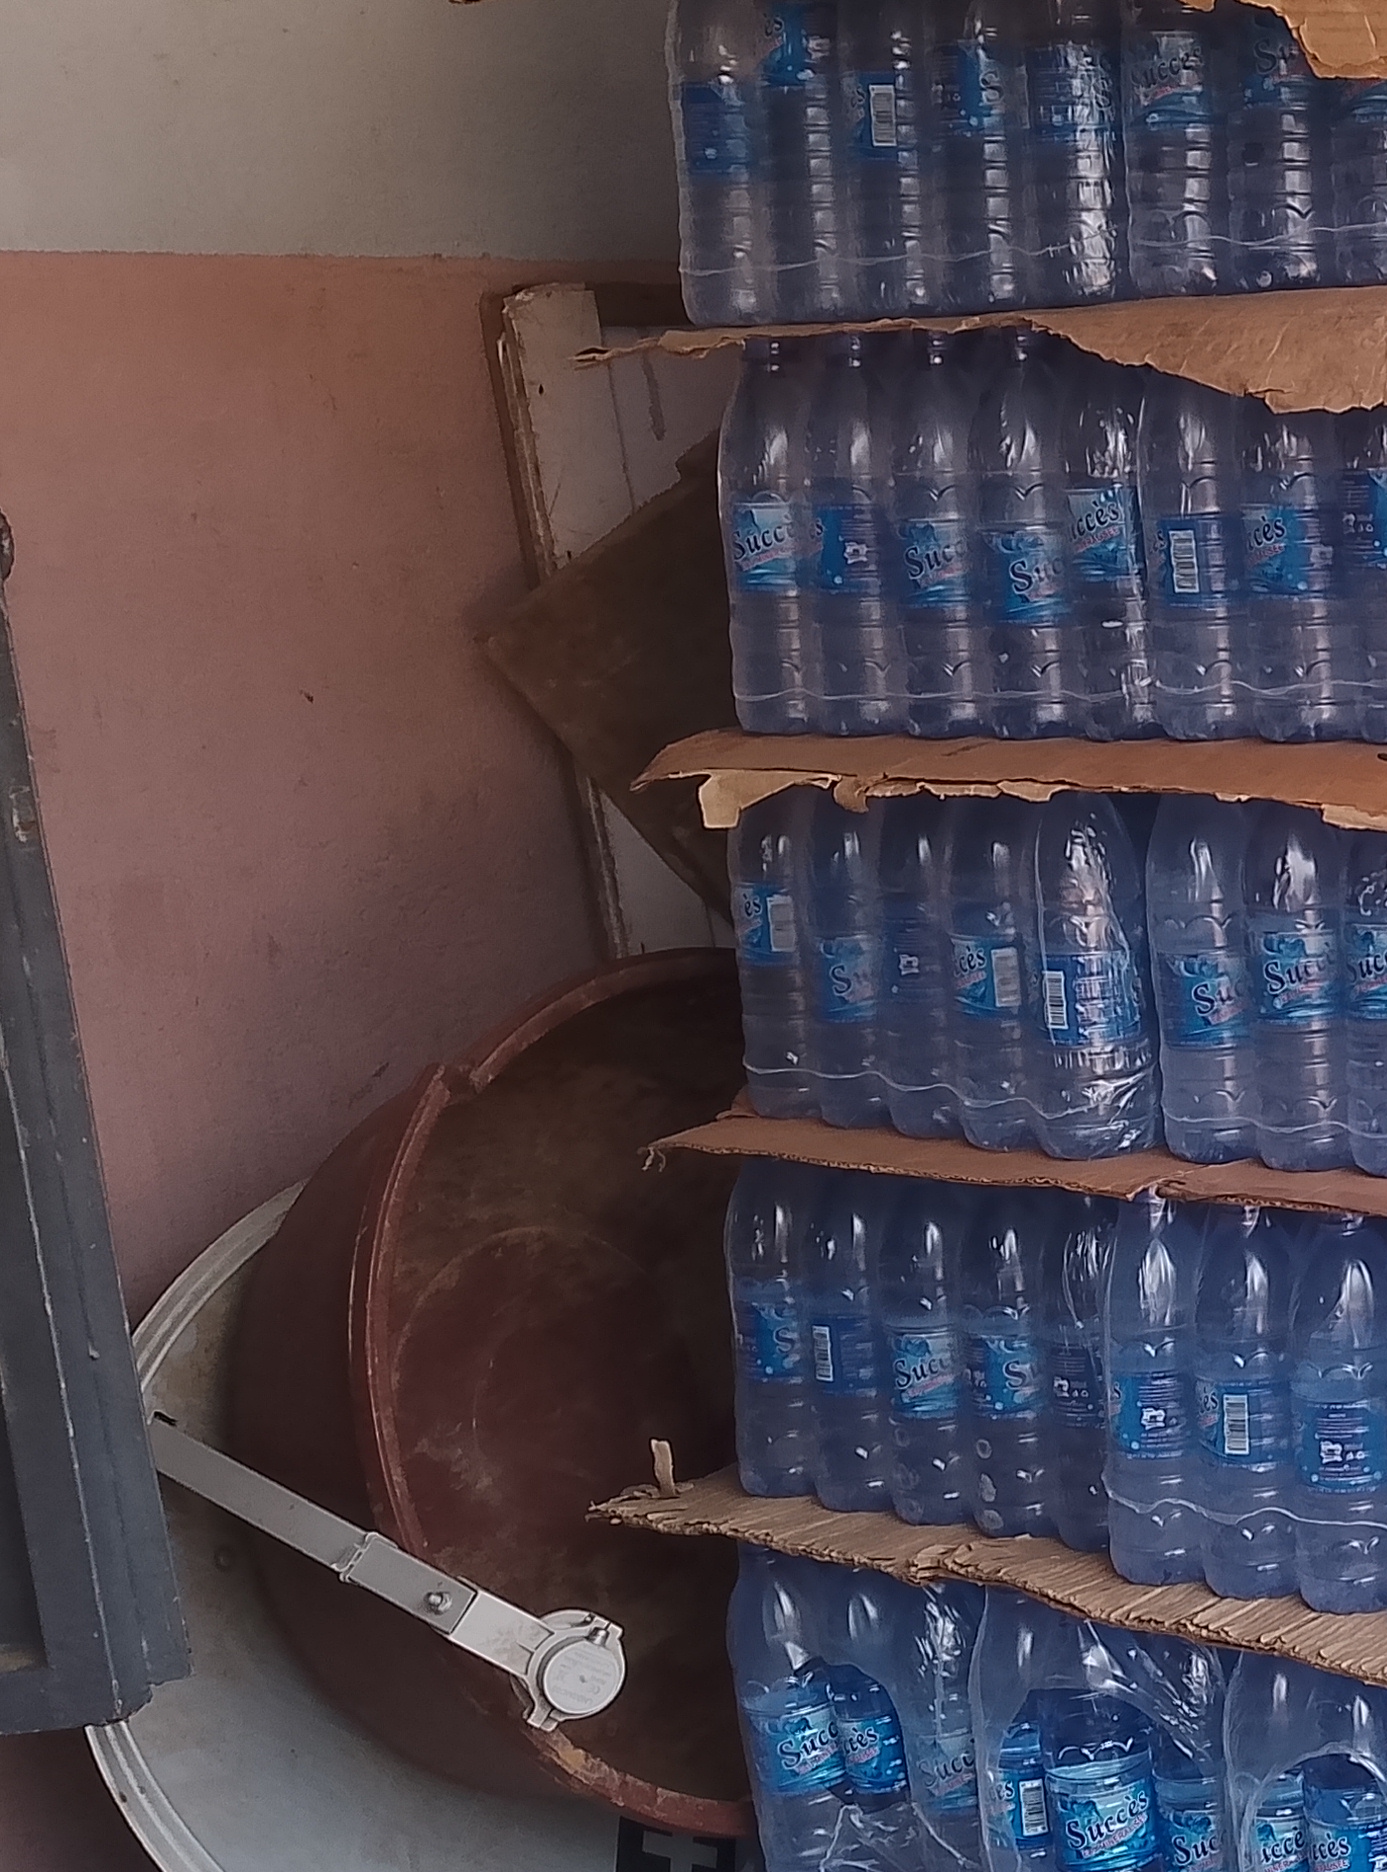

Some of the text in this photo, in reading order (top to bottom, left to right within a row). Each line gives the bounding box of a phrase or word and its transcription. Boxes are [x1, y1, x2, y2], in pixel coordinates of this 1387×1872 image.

[779, 1721, 838, 1769] Succ
[1066, 1793, 1149, 1848] Succès
[1173, 1836, 1220, 1866] Suc
